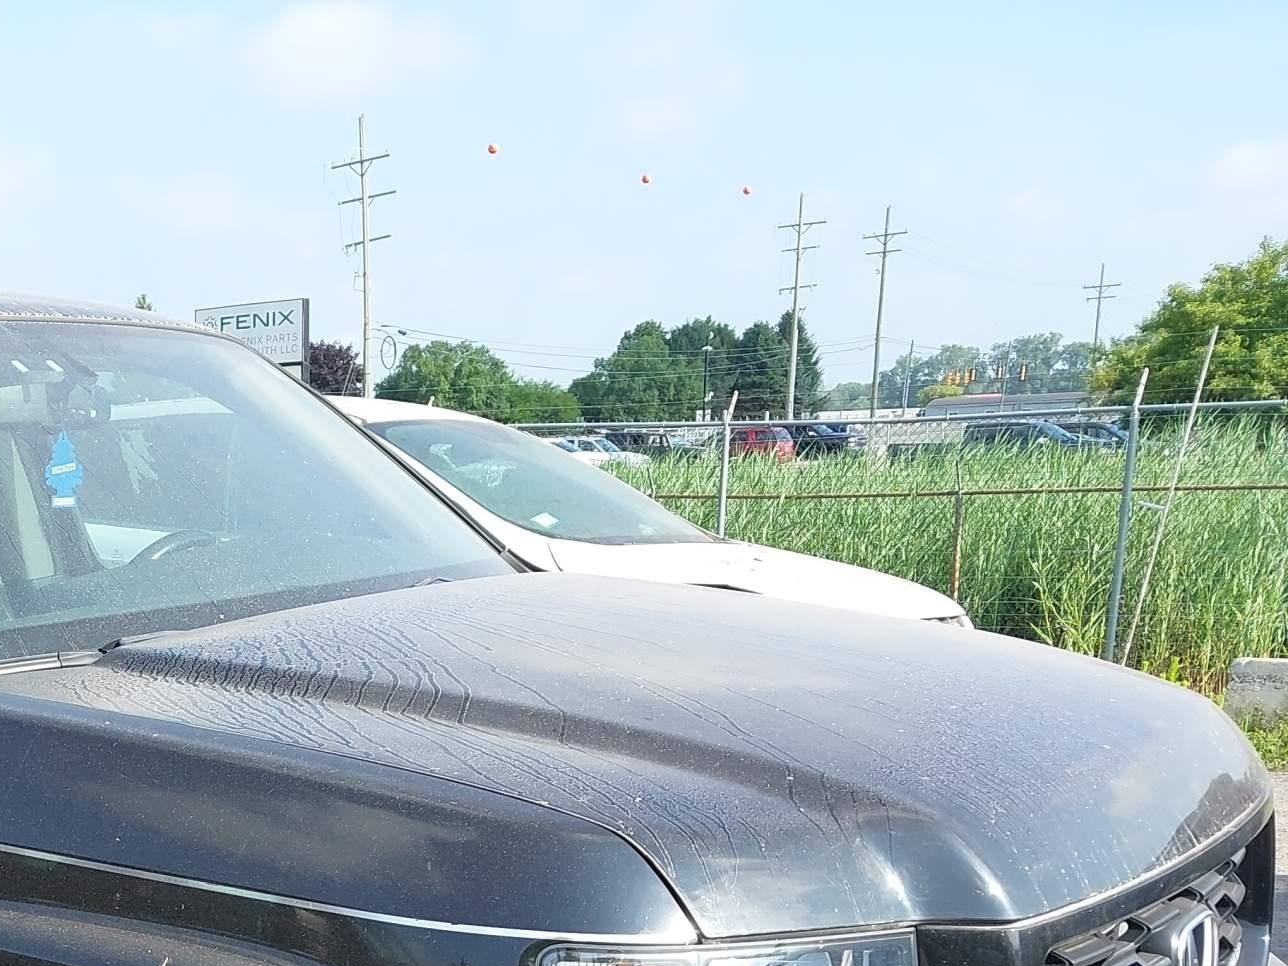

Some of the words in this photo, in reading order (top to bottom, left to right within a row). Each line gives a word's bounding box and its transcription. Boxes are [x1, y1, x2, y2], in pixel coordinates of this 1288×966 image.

[220, 309, 294, 331] FENIX
[240, 335, 263, 345] ENIX
[266, 332, 298, 345] PARTS
[257, 345, 277, 355] UTH
[280, 343, 298, 354] LLC
